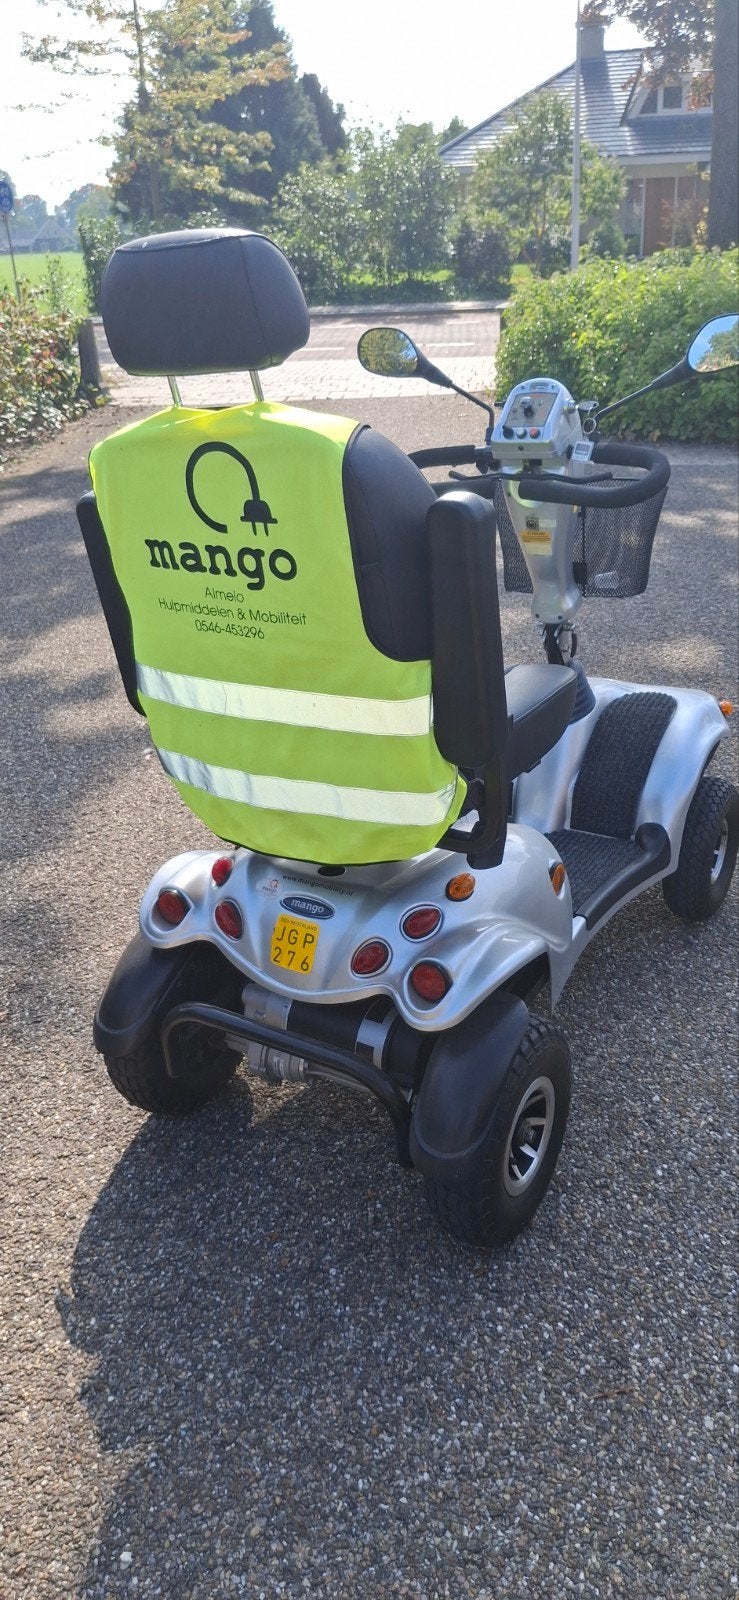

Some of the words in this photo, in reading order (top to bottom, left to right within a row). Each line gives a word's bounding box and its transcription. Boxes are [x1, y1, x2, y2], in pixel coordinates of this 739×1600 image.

[145, 539, 297, 591] mango
[205, 587, 244, 603] Almelo
[158, 598, 234, 619] Hulpmiddelen
[237, 608, 246, 620] &
[249, 609, 307, 626] Mobiliteit
[195, 619, 265, 640] 0546-453296
[291, 899, 325, 914] mango
[276, 926, 315, 949] JGP
[273, 946, 310, 972] 276
